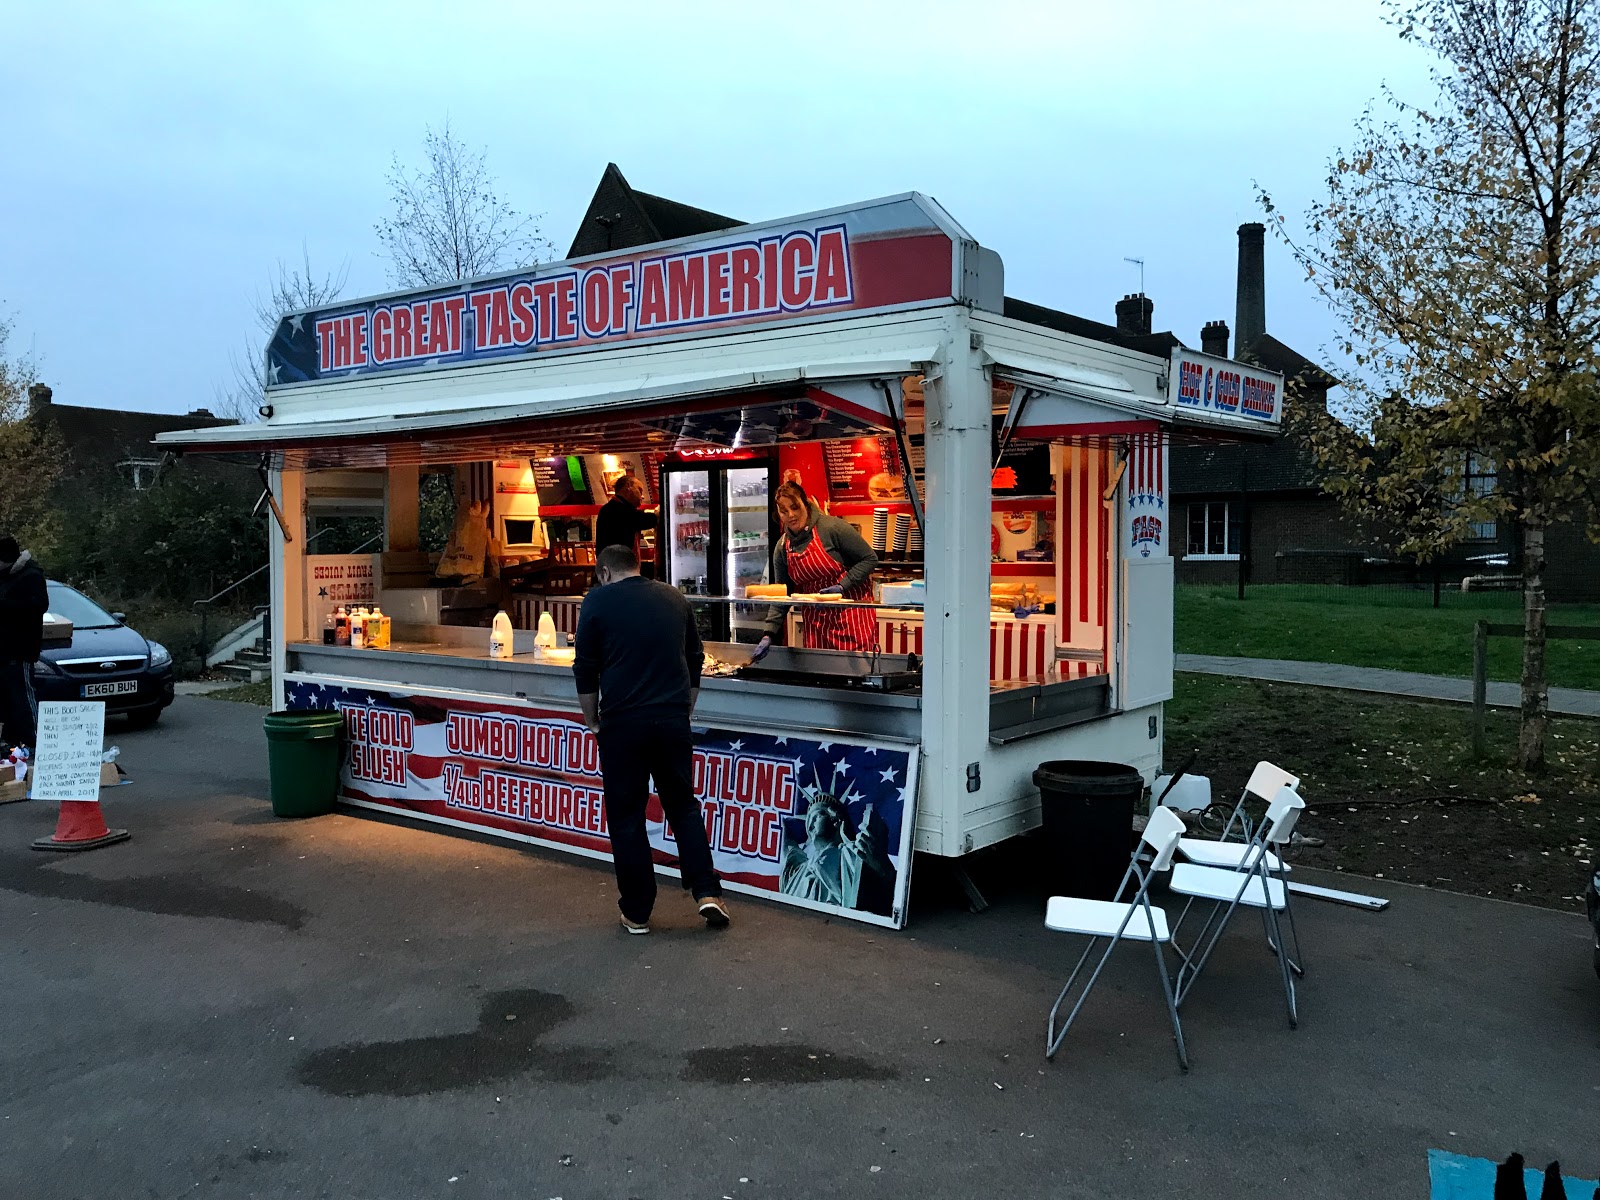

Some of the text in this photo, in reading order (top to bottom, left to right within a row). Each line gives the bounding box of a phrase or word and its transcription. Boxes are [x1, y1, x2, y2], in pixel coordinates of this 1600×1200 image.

[315, 228, 853, 371] THE GREAT TASTE OF AMERICA
[1178, 361, 1276, 419] HOT & COLD DRINKS
[1132, 515, 1162, 547] FAST
[314, 565, 373, 579] FRUIT JUICES
[88, 681, 136, 695] EK60 BUH
[44, 704, 97, 715] THIS BOOT SALE
[62, 723, 83, 731] SUNDAY
[369, 709, 414, 750] COLD
[37, 751, 69, 761] CLOSED
[447, 714, 602, 774] JUMBO HOT DO
[351, 743, 406, 785] SLUSH
[77, 788, 95, 796] 2019
[721, 804, 780, 858] DOG
